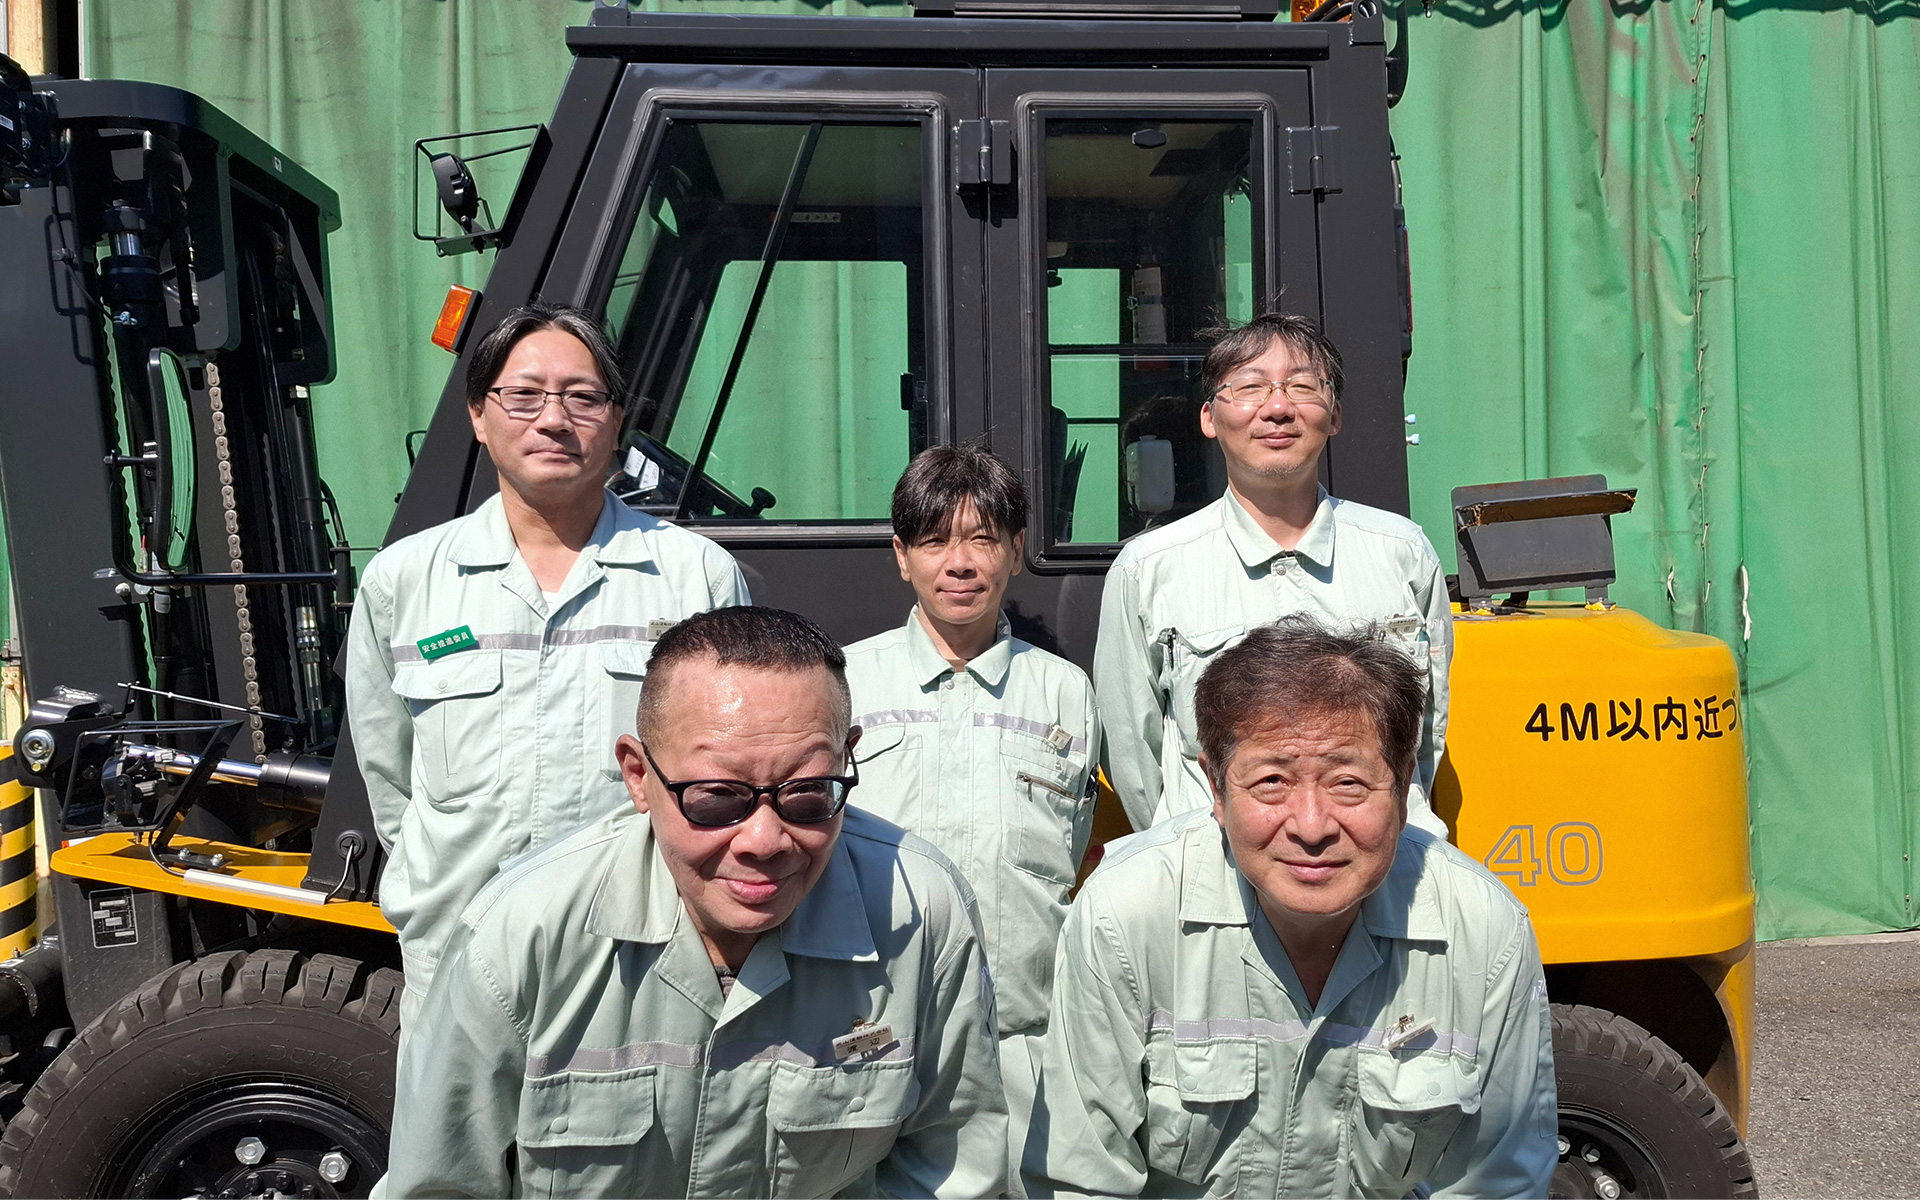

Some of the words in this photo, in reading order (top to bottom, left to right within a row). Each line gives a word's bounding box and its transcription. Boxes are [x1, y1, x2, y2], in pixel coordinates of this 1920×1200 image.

[421, 632, 469, 653] 安全推進委員
[1525, 690, 1742, 742] 4M以内近づ
[1484, 821, 1604, 887] 40
[265, 1044, 393, 1099] DUNLOP
